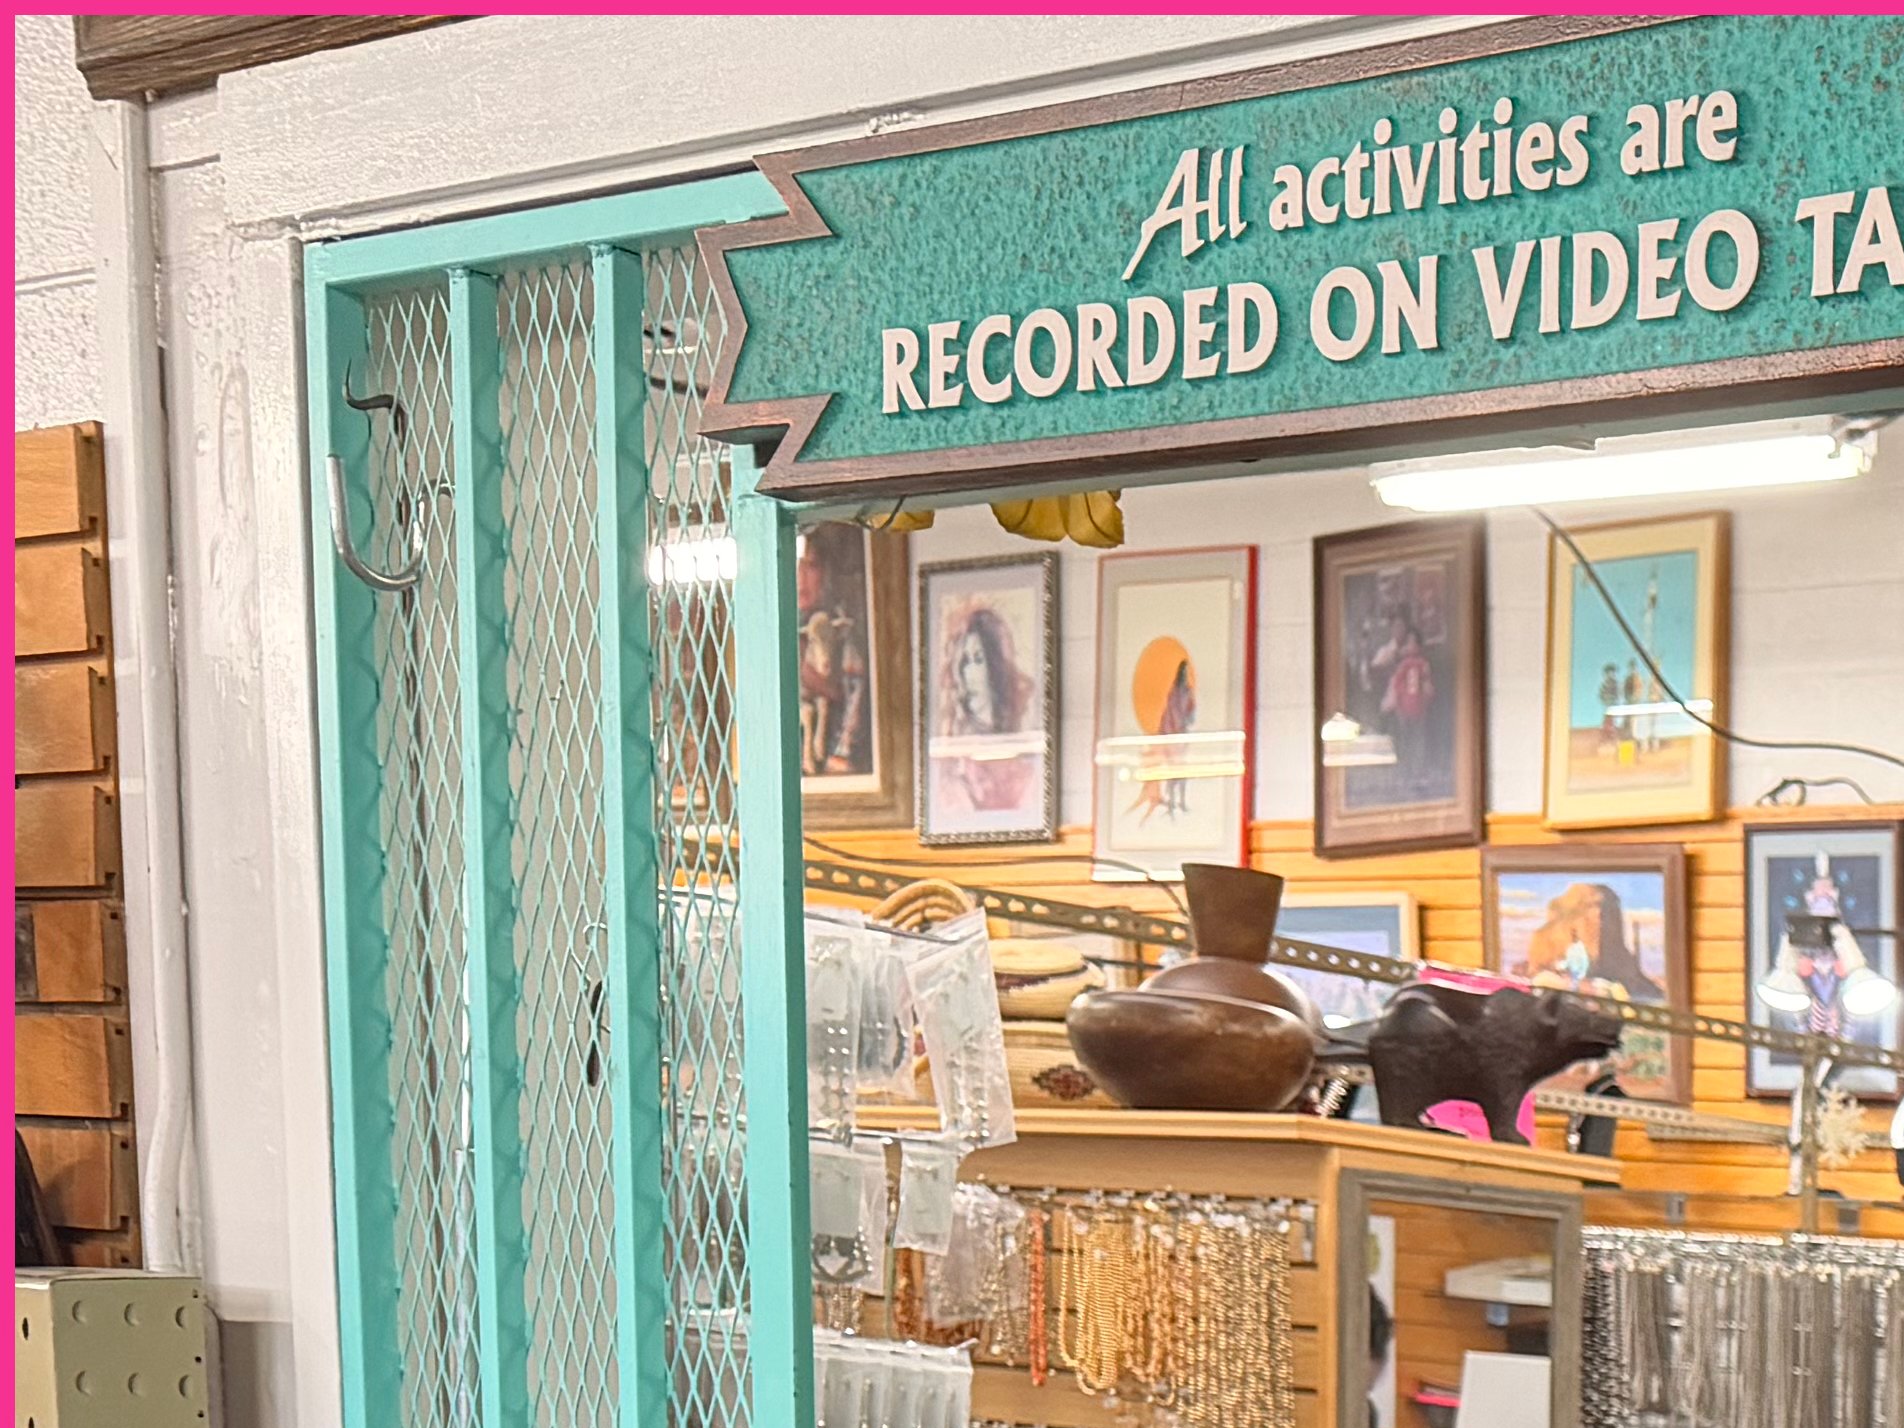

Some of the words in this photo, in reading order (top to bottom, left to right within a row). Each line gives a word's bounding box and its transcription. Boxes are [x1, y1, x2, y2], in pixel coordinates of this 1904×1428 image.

[1121, 145, 1247, 281] All
[1268, 97, 1590, 231] activities
[1619, 90, 1739, 175] are
[881, 281, 1279, 415] RECORDED
[1309, 255, 1439, 362] ON
[1472, 208, 1761, 341] VIDEO
